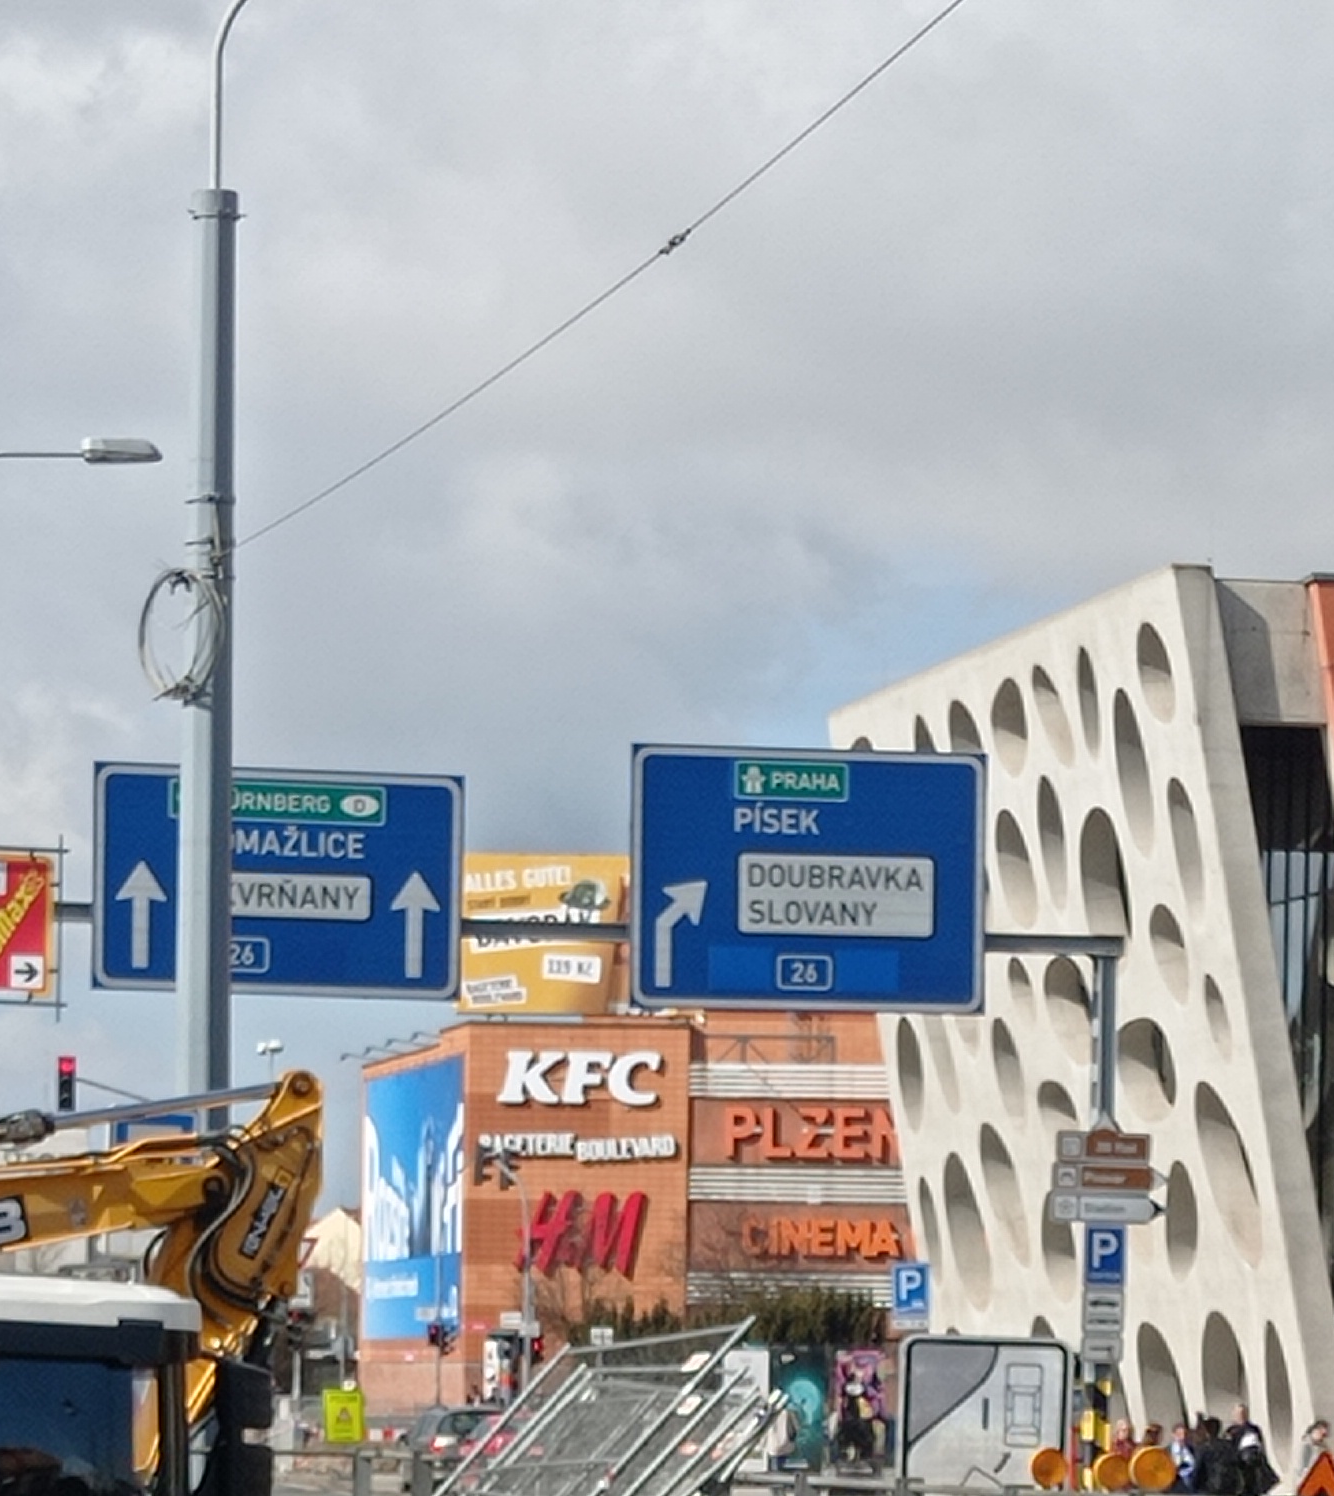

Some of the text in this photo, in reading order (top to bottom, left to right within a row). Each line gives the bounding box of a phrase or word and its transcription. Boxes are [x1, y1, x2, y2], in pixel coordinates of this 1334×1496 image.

[770, 771, 840, 792] PRAHA
[354, 798, 366, 813] D
[733, 802, 820, 835] PÍSEK
[231, 825, 366, 860] MAŽLICE
[747, 862, 924, 891] DOUBRAVKA
[232, 877, 361, 911] VRŇANY
[748, 899, 878, 927] SLOVANY
[789, 961, 818, 984] 26
[496, 1050, 663, 1106] KFC
[477, 1133, 676, 1162] BAGETERIE BOULEVARD
[741, 1214, 901, 1257] CINEMA
[1092, 1231, 1119, 1269] P
[898, 1269, 922, 1301] P
